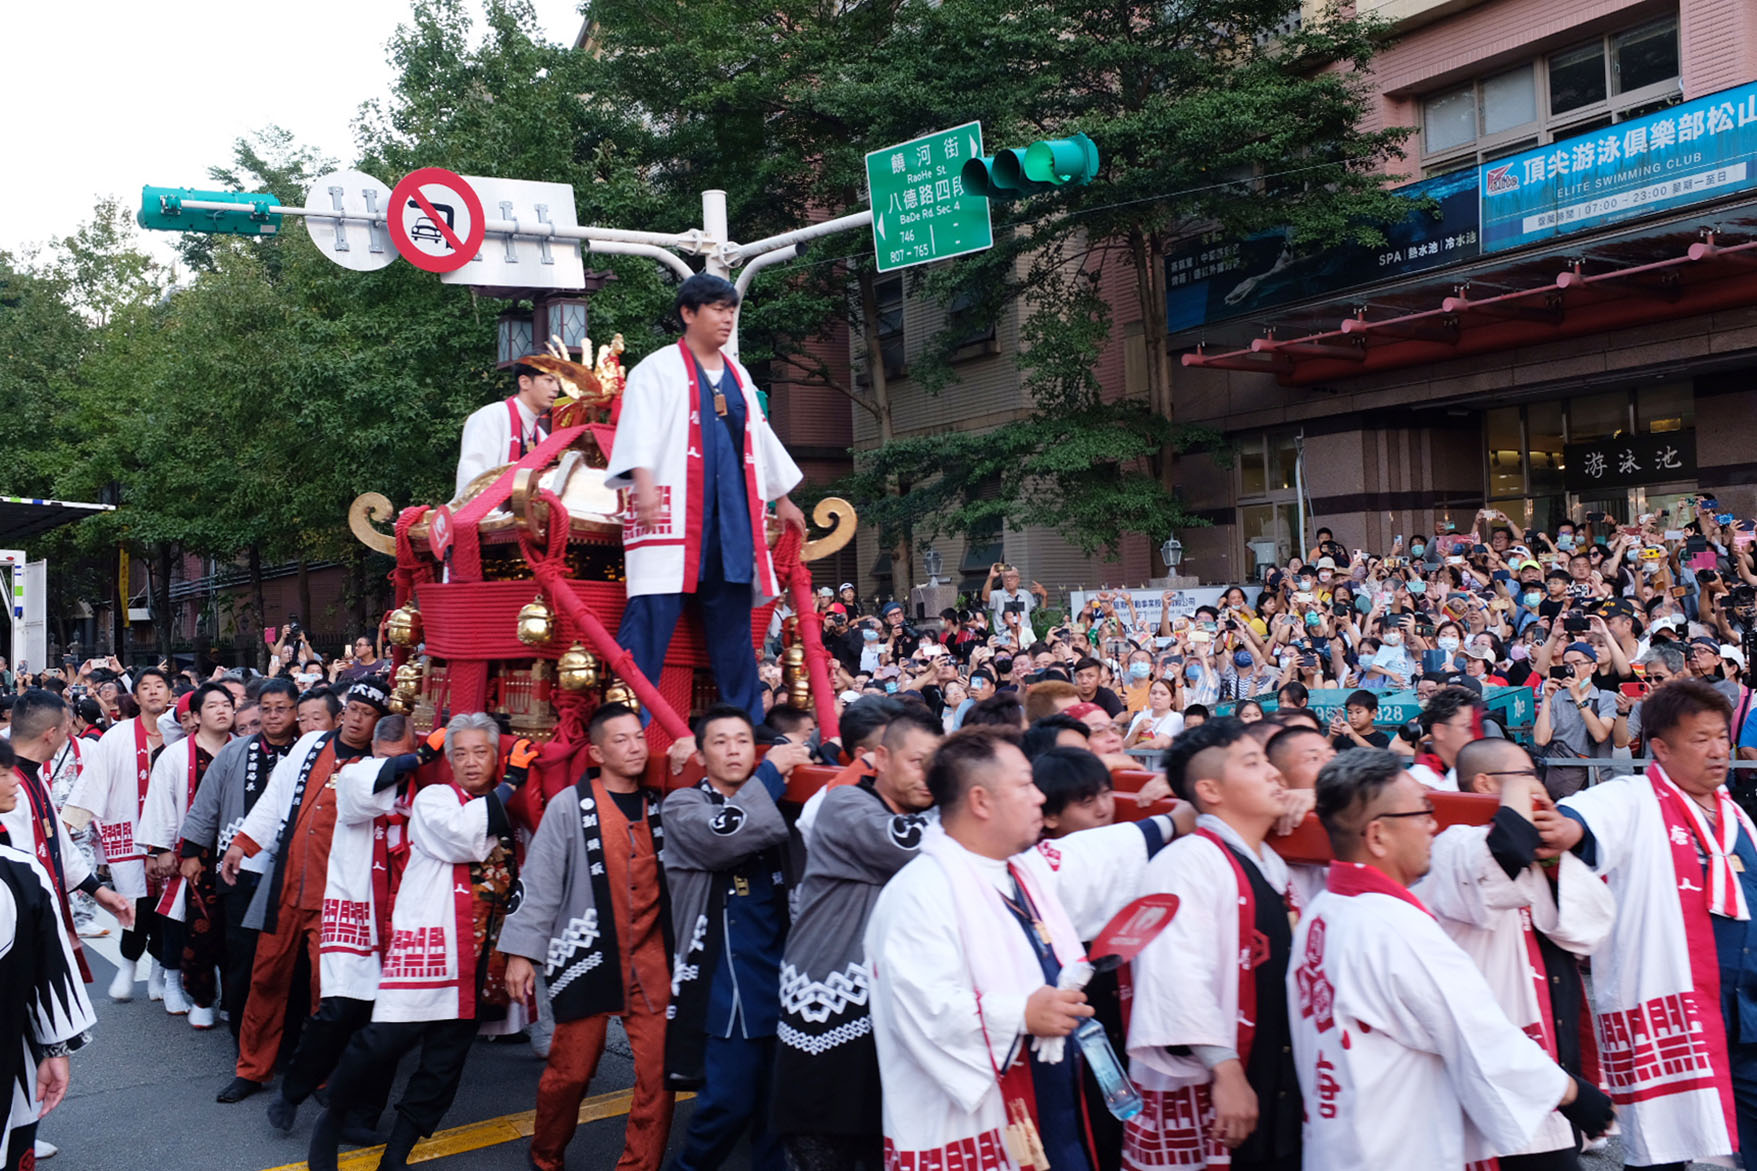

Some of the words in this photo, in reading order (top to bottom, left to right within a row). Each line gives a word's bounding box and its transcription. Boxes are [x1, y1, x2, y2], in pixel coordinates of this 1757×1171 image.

[890, 135, 960, 175] 饒河街
[1523, 94, 1757, 186] 頂尖游泳俱樂部松山
[907, 170, 932, 185] RaoHe
[1557, 180, 1590, 199] ELITE
[1595, 163, 1662, 189] SWIMMING
[1666, 152, 1702, 171] CLUB
[899, 212, 921, 225] BaDe
[953, 200, 960, 211] 4
[1584, 198, 1618, 216] 07:00
[1633, 185, 1668, 203] 23:00
[900, 230, 915, 244] 746
[1378, 252, 1402, 267] SPA
[1584, 445, 1682, 479] 游泳池
